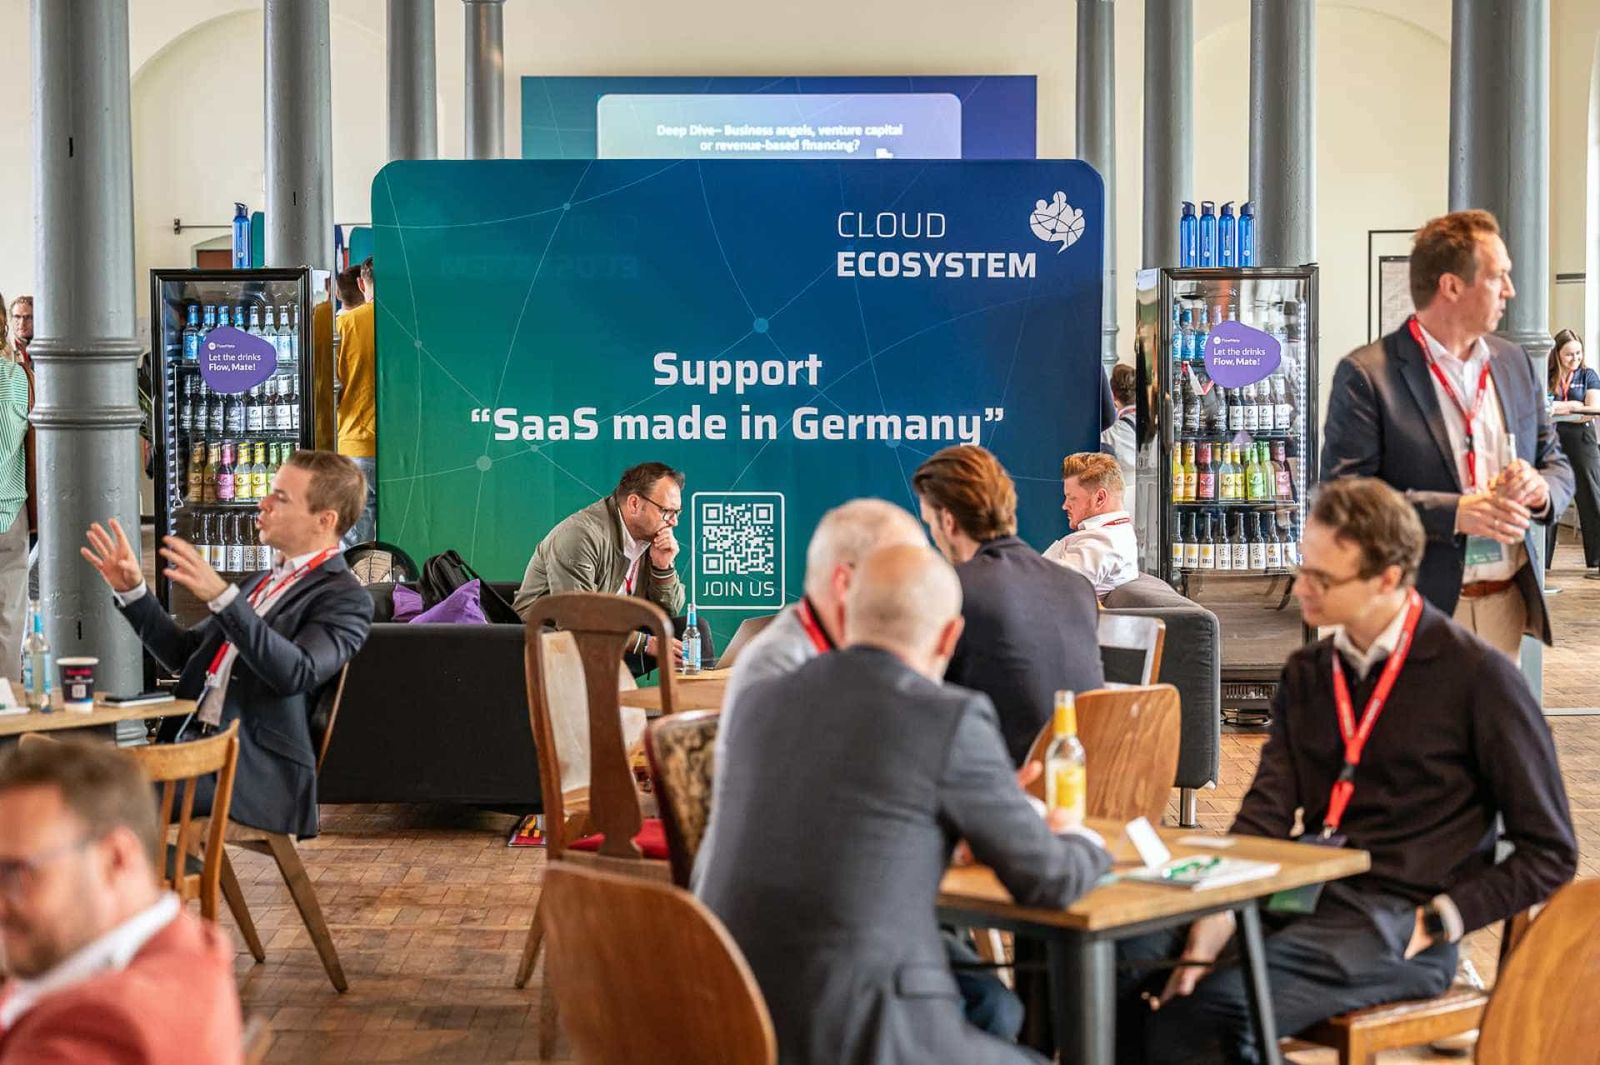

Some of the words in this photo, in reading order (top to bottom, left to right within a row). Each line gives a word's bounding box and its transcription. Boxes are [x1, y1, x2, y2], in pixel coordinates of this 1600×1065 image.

[656, 123, 687, 137] Deep
[724, 124, 773, 137] Business
[776, 124, 815, 138] angels,
[818, 126, 863, 137] venture
[865, 123, 903, 138] capital
[699, 141, 713, 151] or
[715, 140, 799, 151] revenue-based
[801, 139, 860, 152] financing?
[837, 212, 946, 239] CLOUD
[837, 251, 1036, 278] ECOSYSTEM
[223, 353, 235, 361] the
[237, 353, 262, 361] drinks
[1213, 348, 1226, 356] Let
[1227, 348, 1240, 356] the
[1242, 347, 1266, 356] drinks
[208, 363, 231, 372] Flow,
[231, 363, 257, 372] Mate!
[1213, 357, 1235, 366] Flow,
[1236, 357, 1260, 366] Mate!
[653, 352, 822, 394] Support
[613, 405, 727, 440] made
[741, 405, 777, 440] in
[703, 581, 743, 597] JOIN
[749, 581, 775, 597] US
